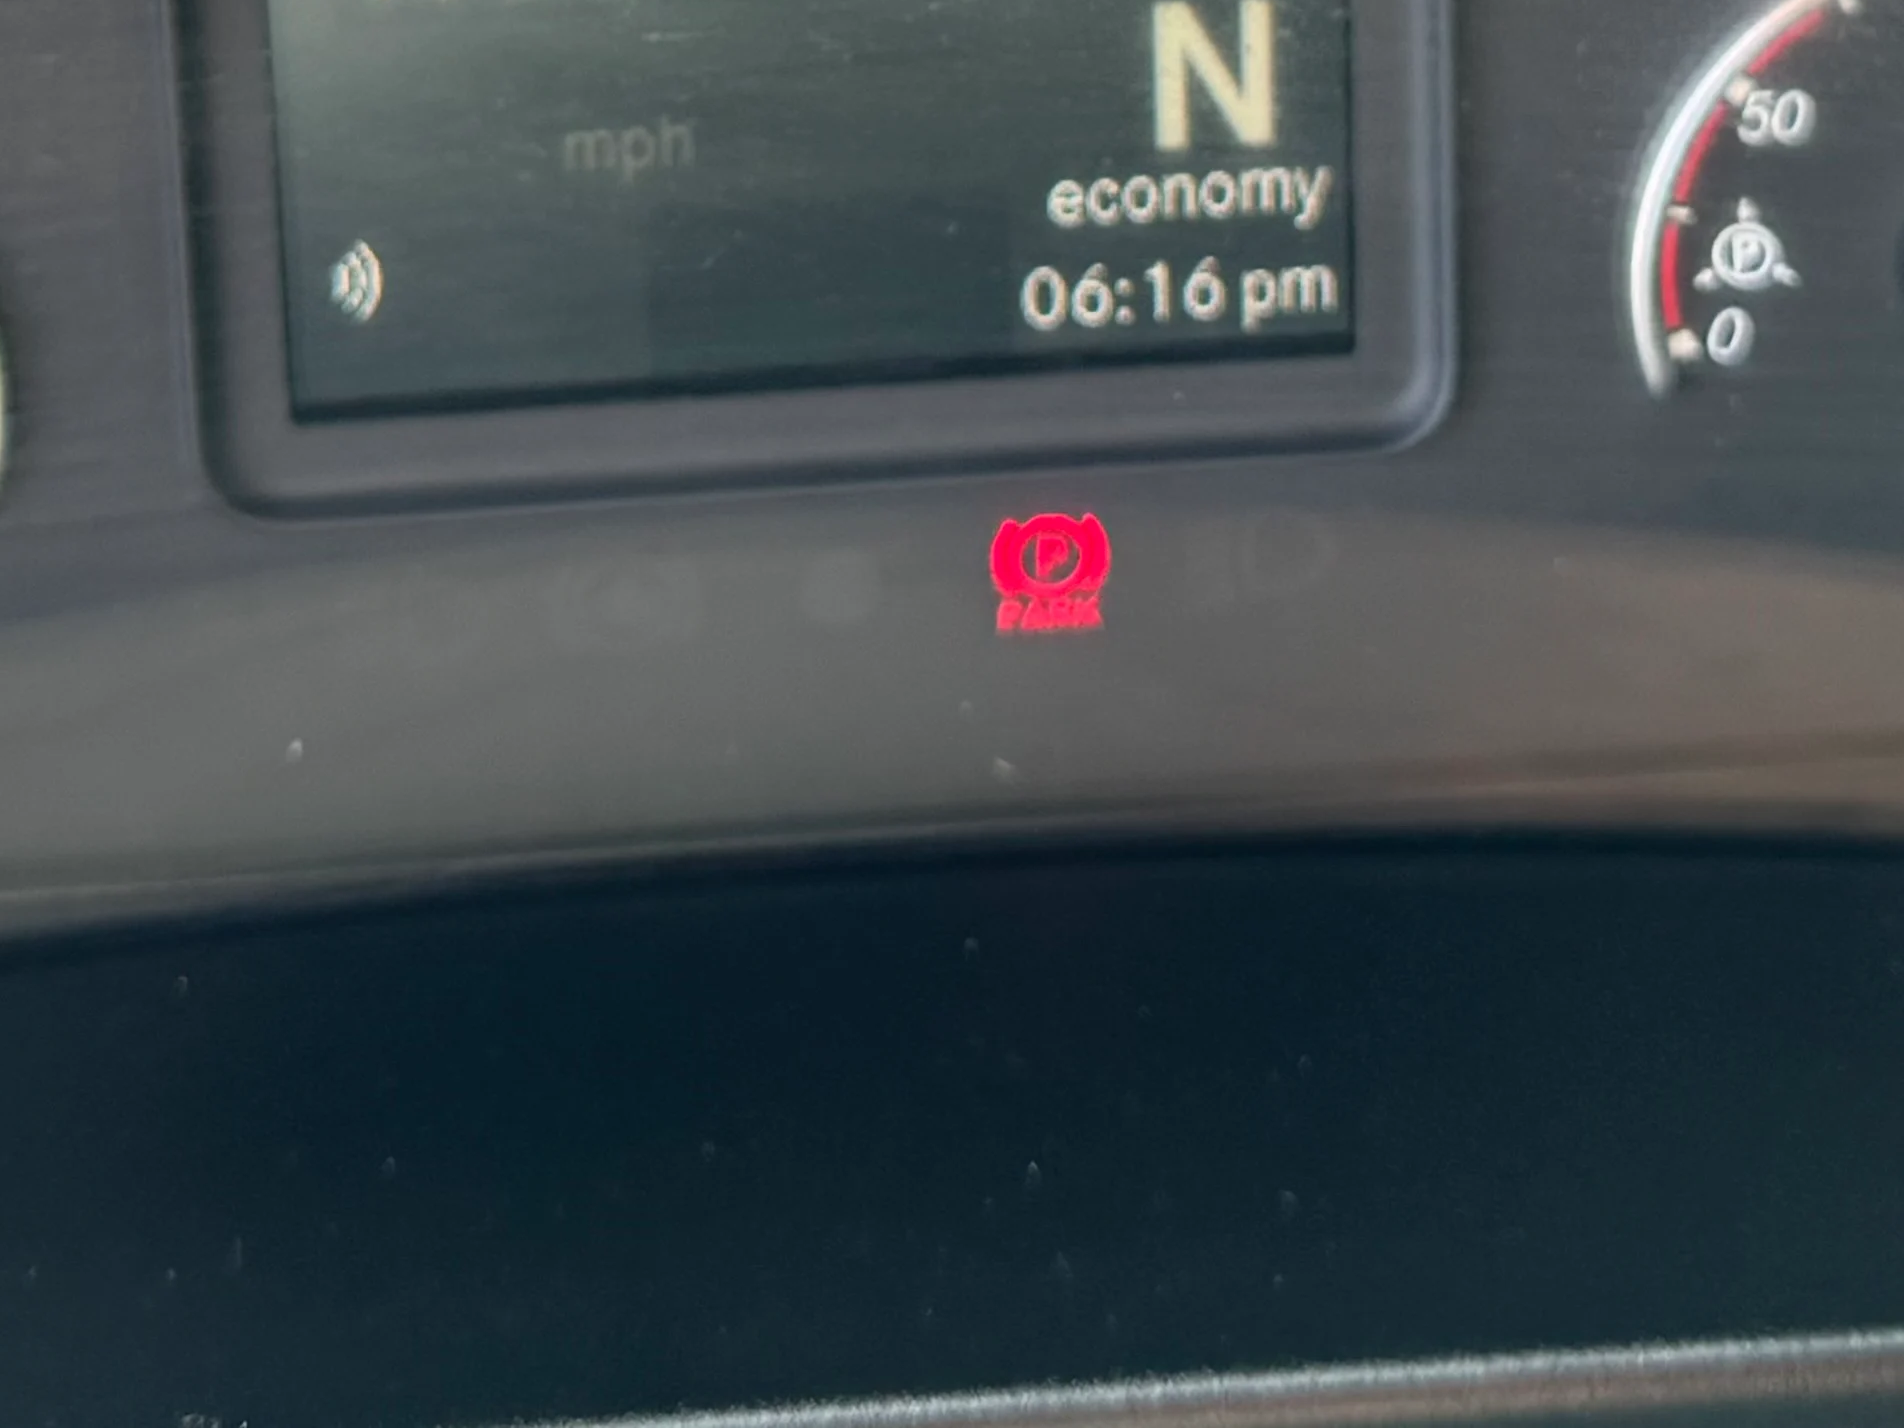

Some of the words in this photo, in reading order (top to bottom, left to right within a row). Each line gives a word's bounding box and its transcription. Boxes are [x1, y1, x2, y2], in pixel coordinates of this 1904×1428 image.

[562, 116, 696, 182] mph
[1736, 88, 1818, 147] 50
[1046, 162, 1332, 230] economy
[1021, 259, 1226, 332] 06:16
[1240, 256, 1340, 330] pm
[1706, 304, 1756, 367] 0
